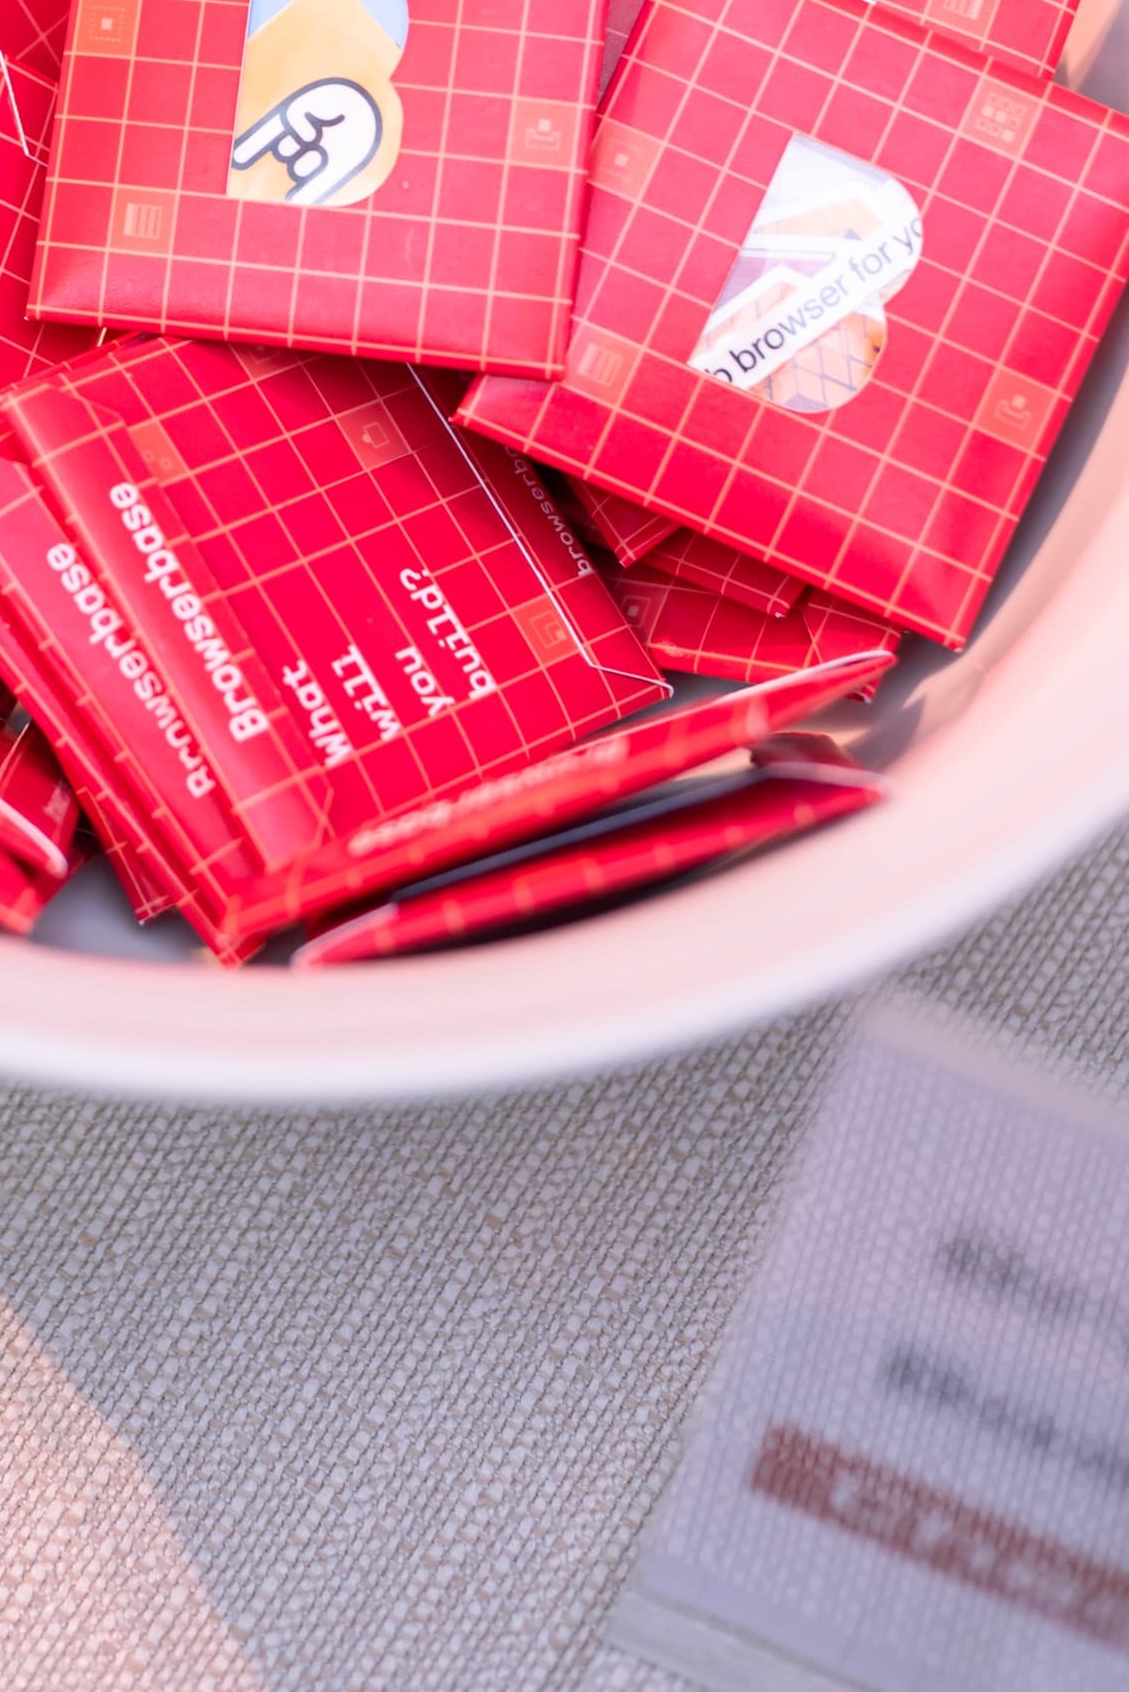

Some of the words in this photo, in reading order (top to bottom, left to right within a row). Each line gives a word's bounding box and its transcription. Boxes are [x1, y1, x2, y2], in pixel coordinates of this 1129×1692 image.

[728, 275, 849, 373] browser
[847, 242, 893, 283] for
[110, 481, 269, 744] Browserbase
[399, 566, 496, 700] build?
[280, 660, 350, 766] What
[331, 644, 402, 742] will
[394, 647, 456, 719] you
